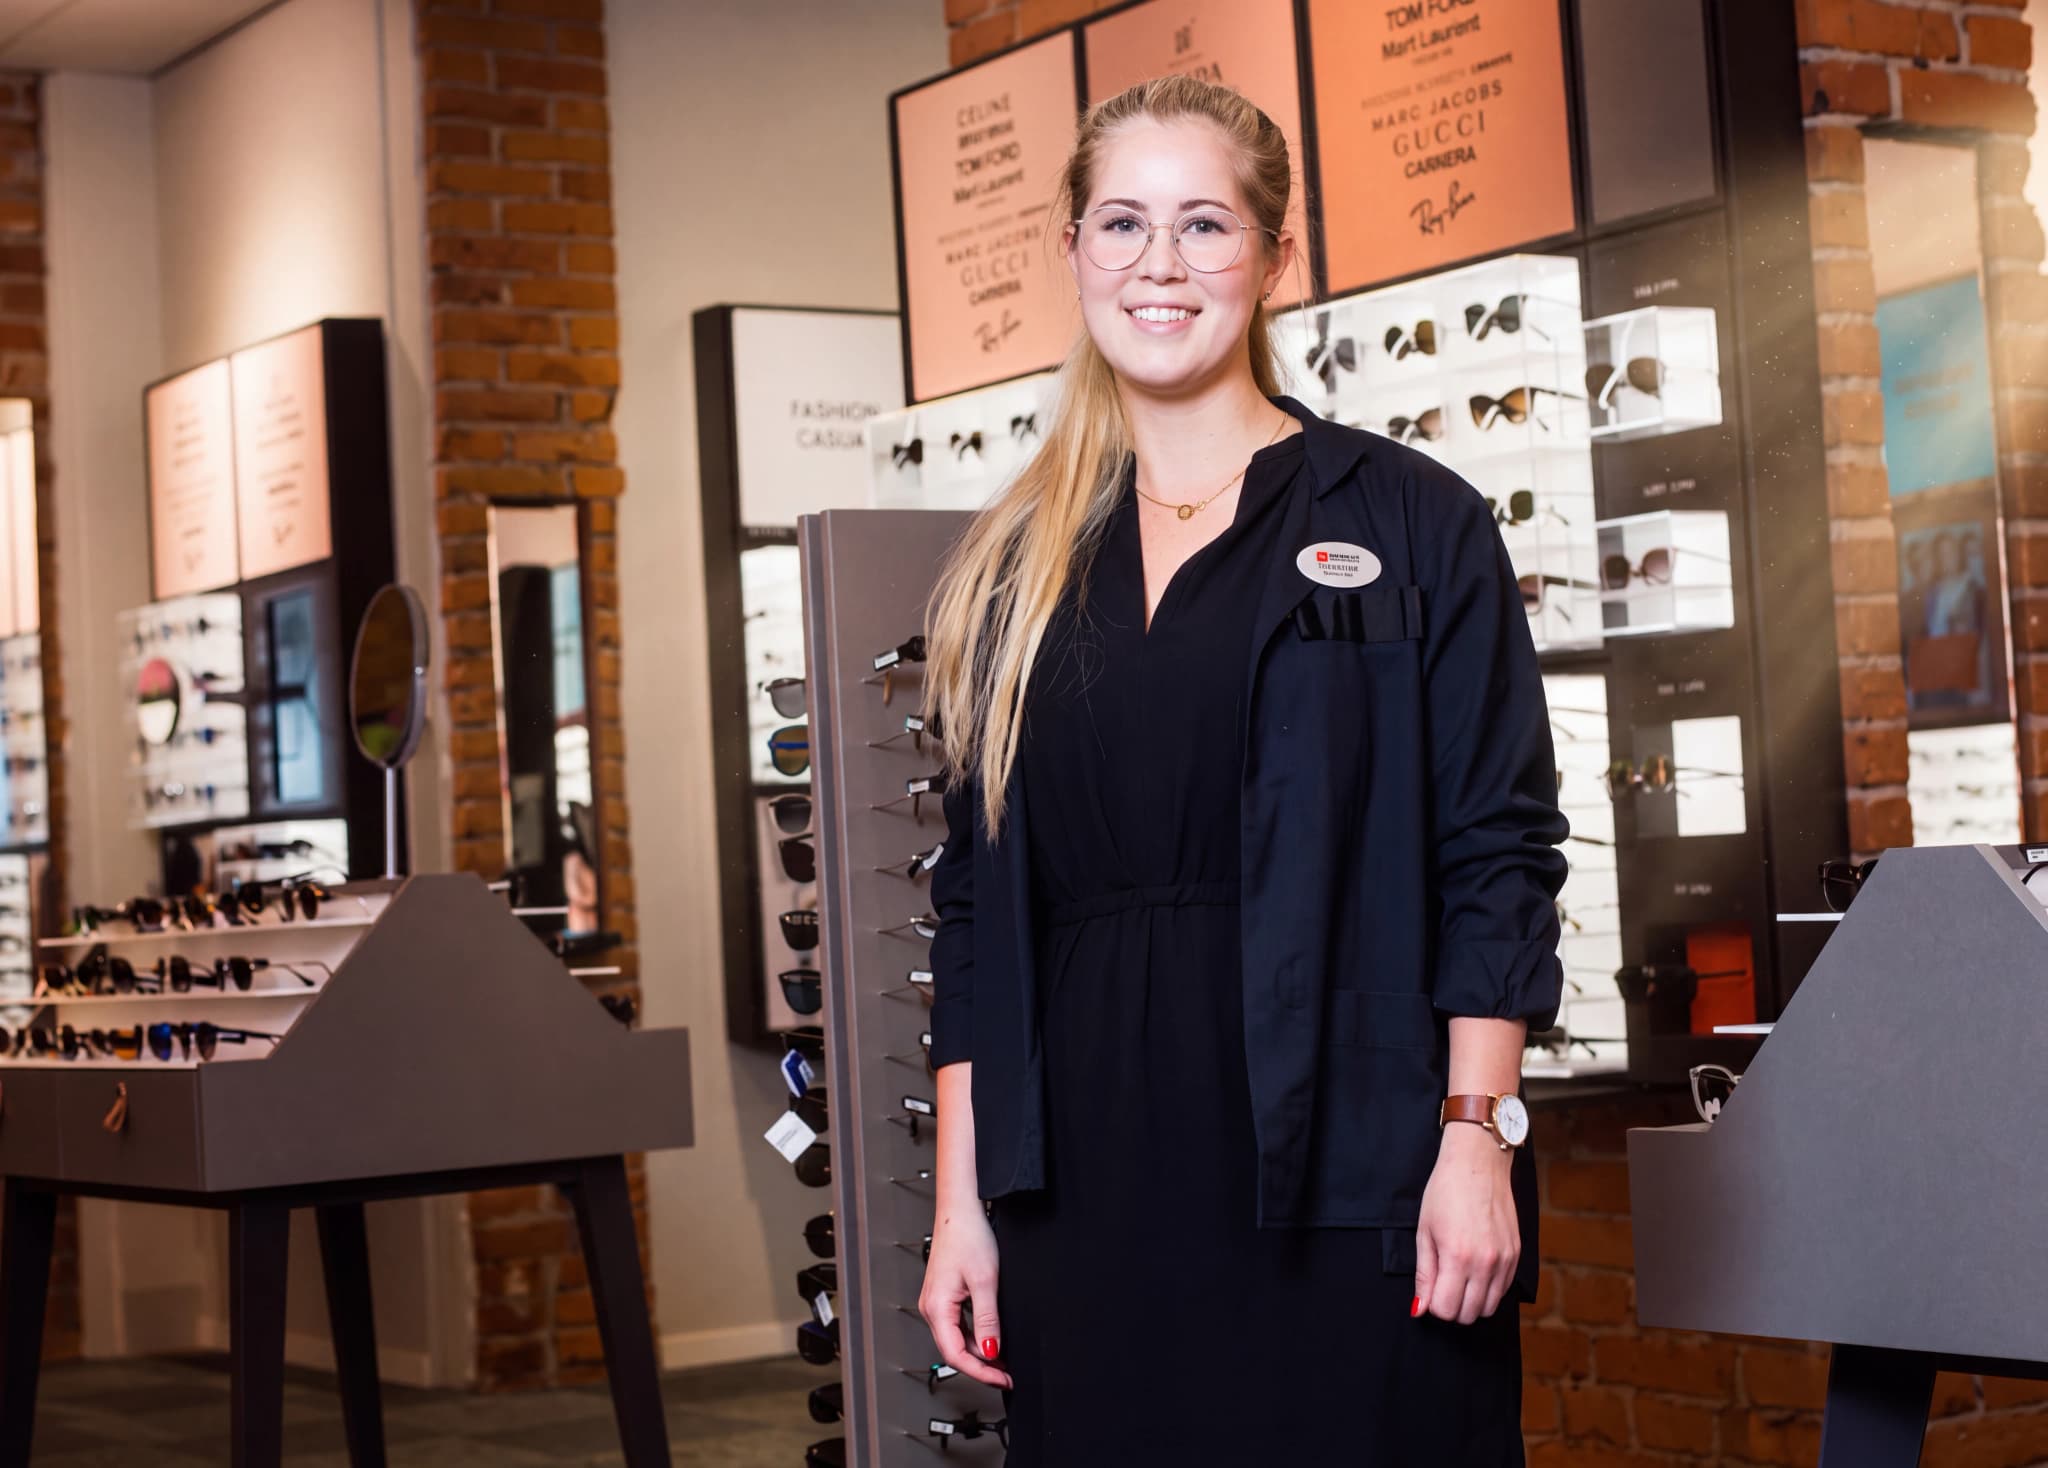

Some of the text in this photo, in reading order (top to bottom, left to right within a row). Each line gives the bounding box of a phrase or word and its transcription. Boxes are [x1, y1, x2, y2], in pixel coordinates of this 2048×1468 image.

[1385, 1, 1423, 31] TOM
[1372, 104, 1420, 132] MARC
[1431, 79, 1503, 116] JACOBS
[1393, 109, 1485, 157] GUCCI
[960, 249, 1029, 288] GUCCI
[790, 399, 880, 420] FASHION
[796, 427, 864, 450] CASUA
